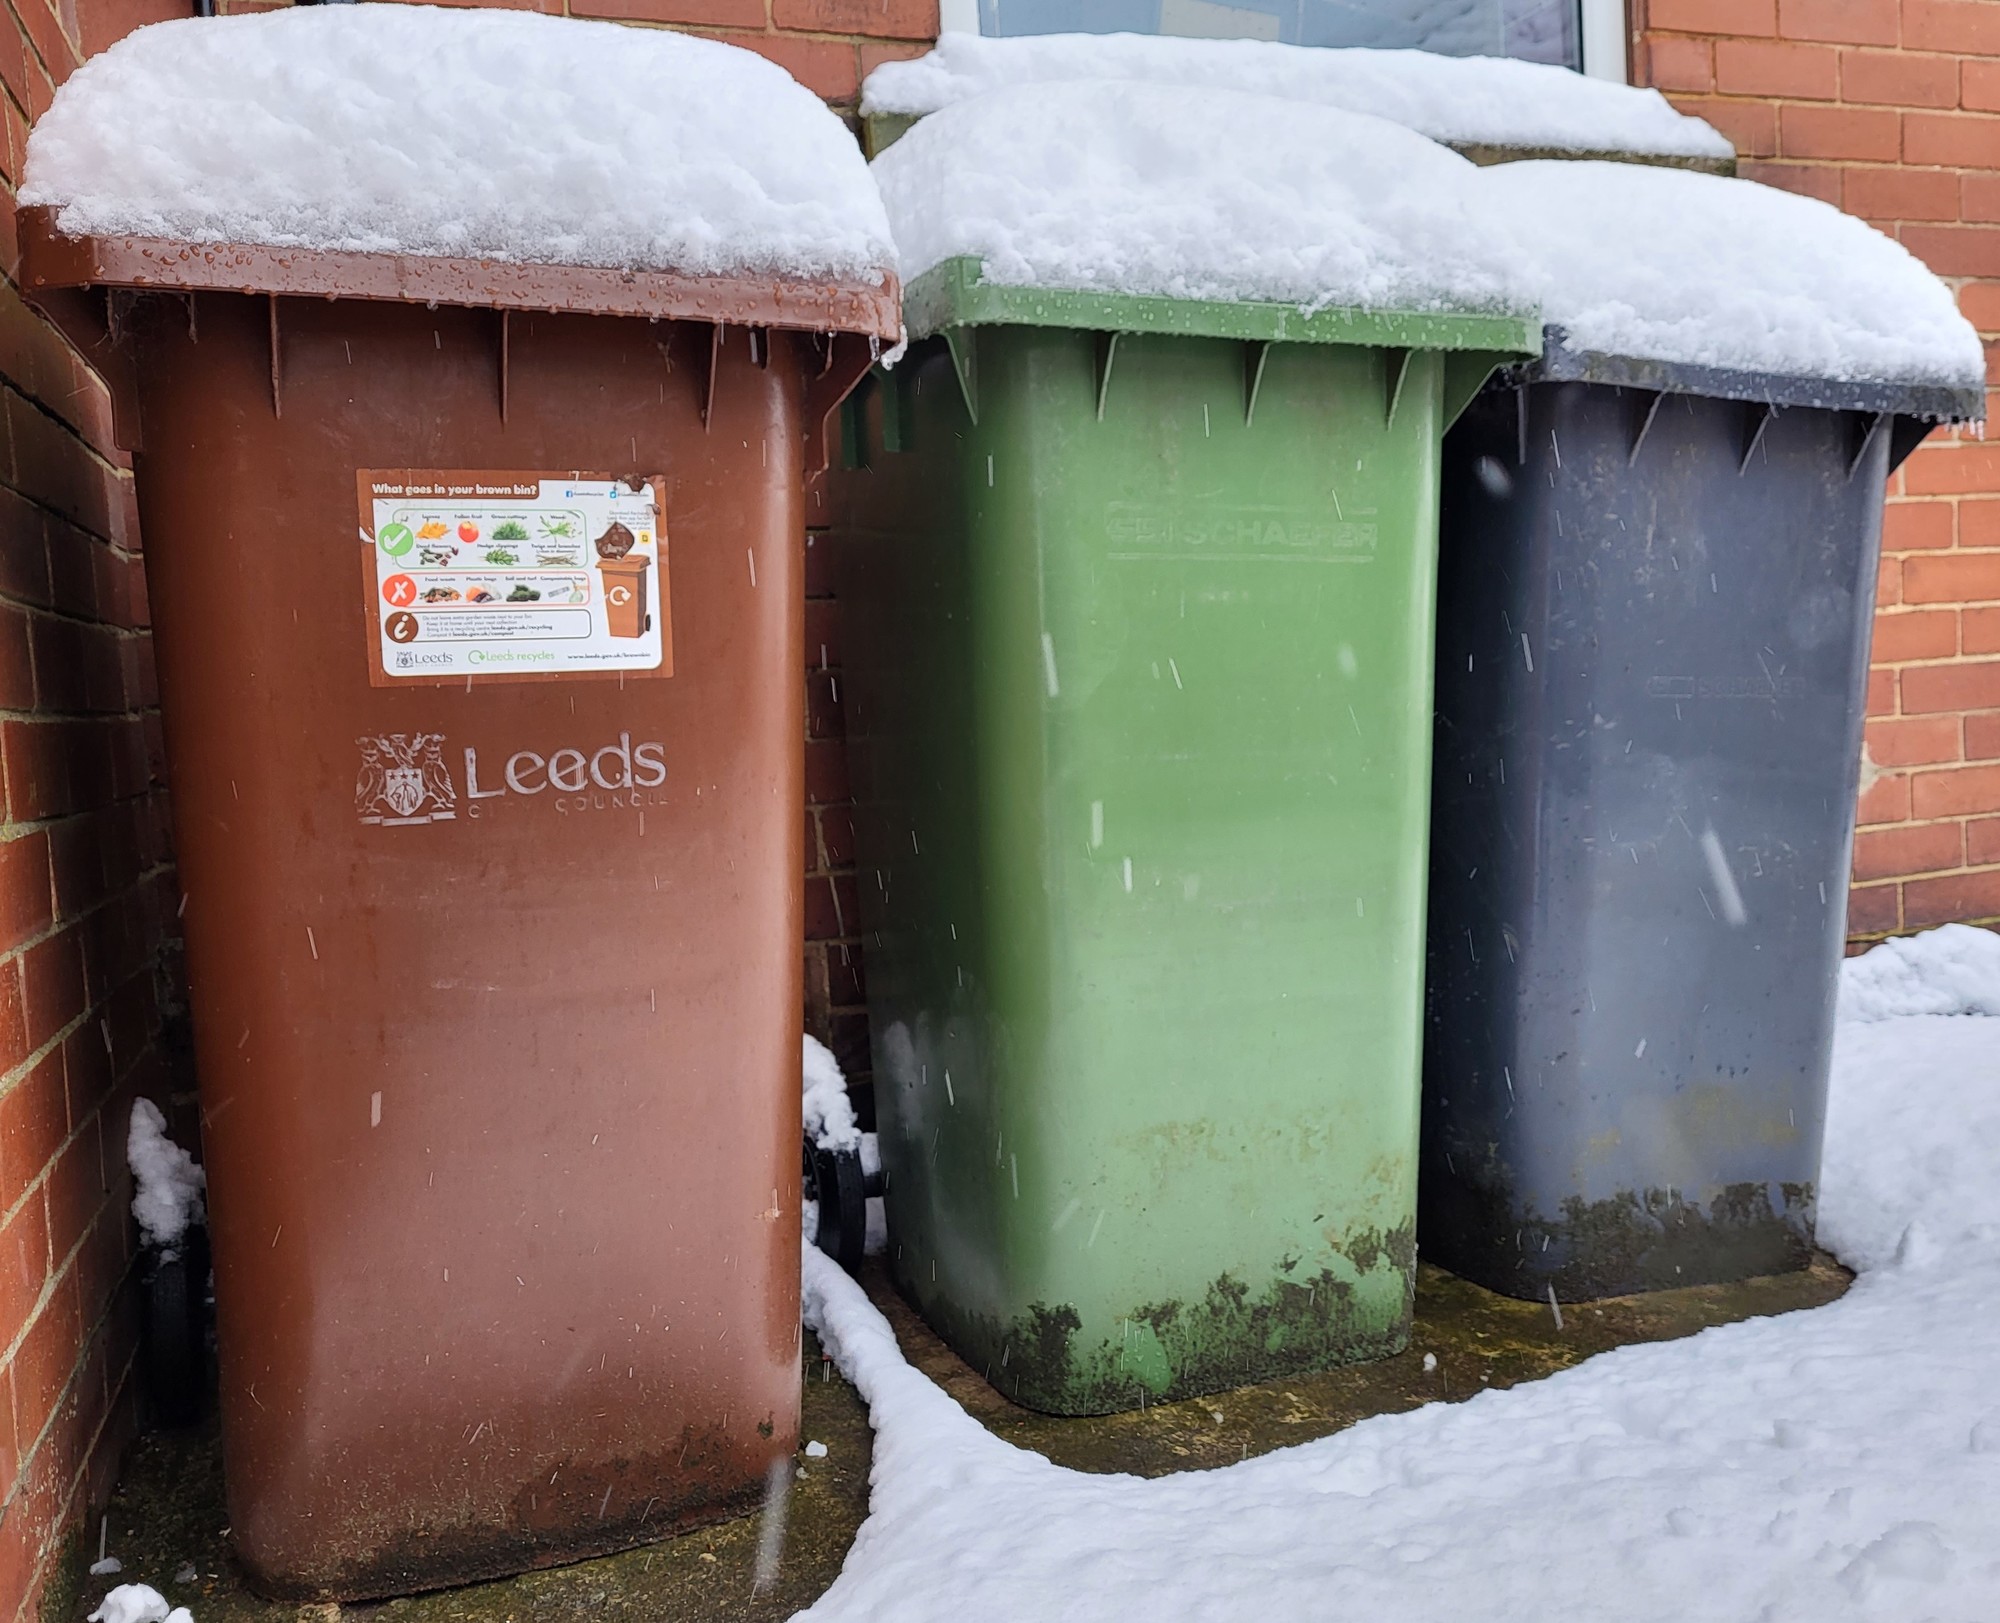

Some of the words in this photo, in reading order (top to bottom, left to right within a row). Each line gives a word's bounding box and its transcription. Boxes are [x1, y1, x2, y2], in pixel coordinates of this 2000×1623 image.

[372, 483, 403, 494] What
[405, 485, 432, 496] goes
[434, 483, 446, 494] in
[448, 485, 473, 496] your
[476, 483, 512, 495] brown
[513, 484, 537, 495] bin?
[414, 652, 454, 664] Leeds
[486, 648, 514, 662] Leeds
[516, 650, 556, 662] recycles
[463, 730, 667, 799] Leeds
[554, 792, 670, 816] COUNCIL
